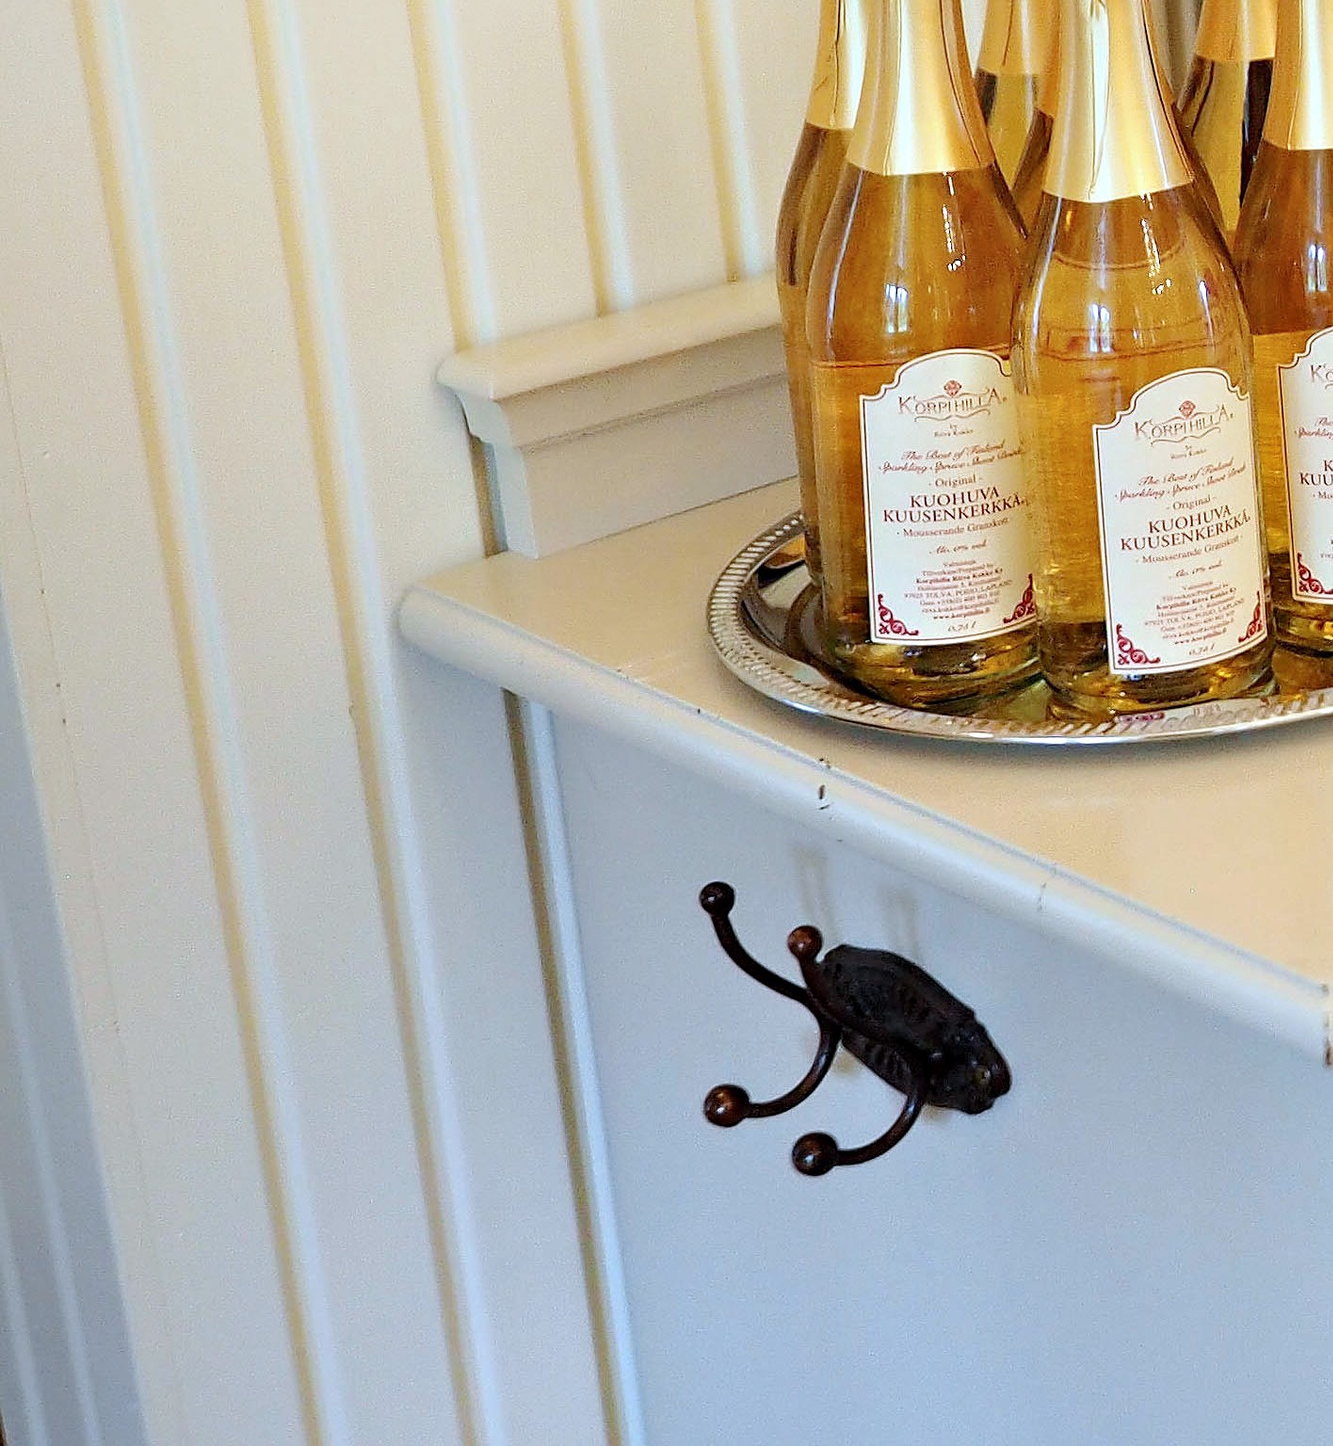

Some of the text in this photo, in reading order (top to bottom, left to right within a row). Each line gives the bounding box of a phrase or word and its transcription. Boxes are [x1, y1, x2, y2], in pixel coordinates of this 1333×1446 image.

[898, 387, 1001, 415] KORPIHILLA
[1134, 404, 1230, 440] KORPIHILLA
[935, 474, 977, 487] Original
[883, 491, 1023, 523] KUUSENKERKKÄ
[910, 485, 1000, 508] KUOHUVA
[1172, 494, 1211, 510] Original
[1120, 509, 1249, 551] KUUSENKERKKÄ
[1148, 504, 1232, 534] KUOHUVA
